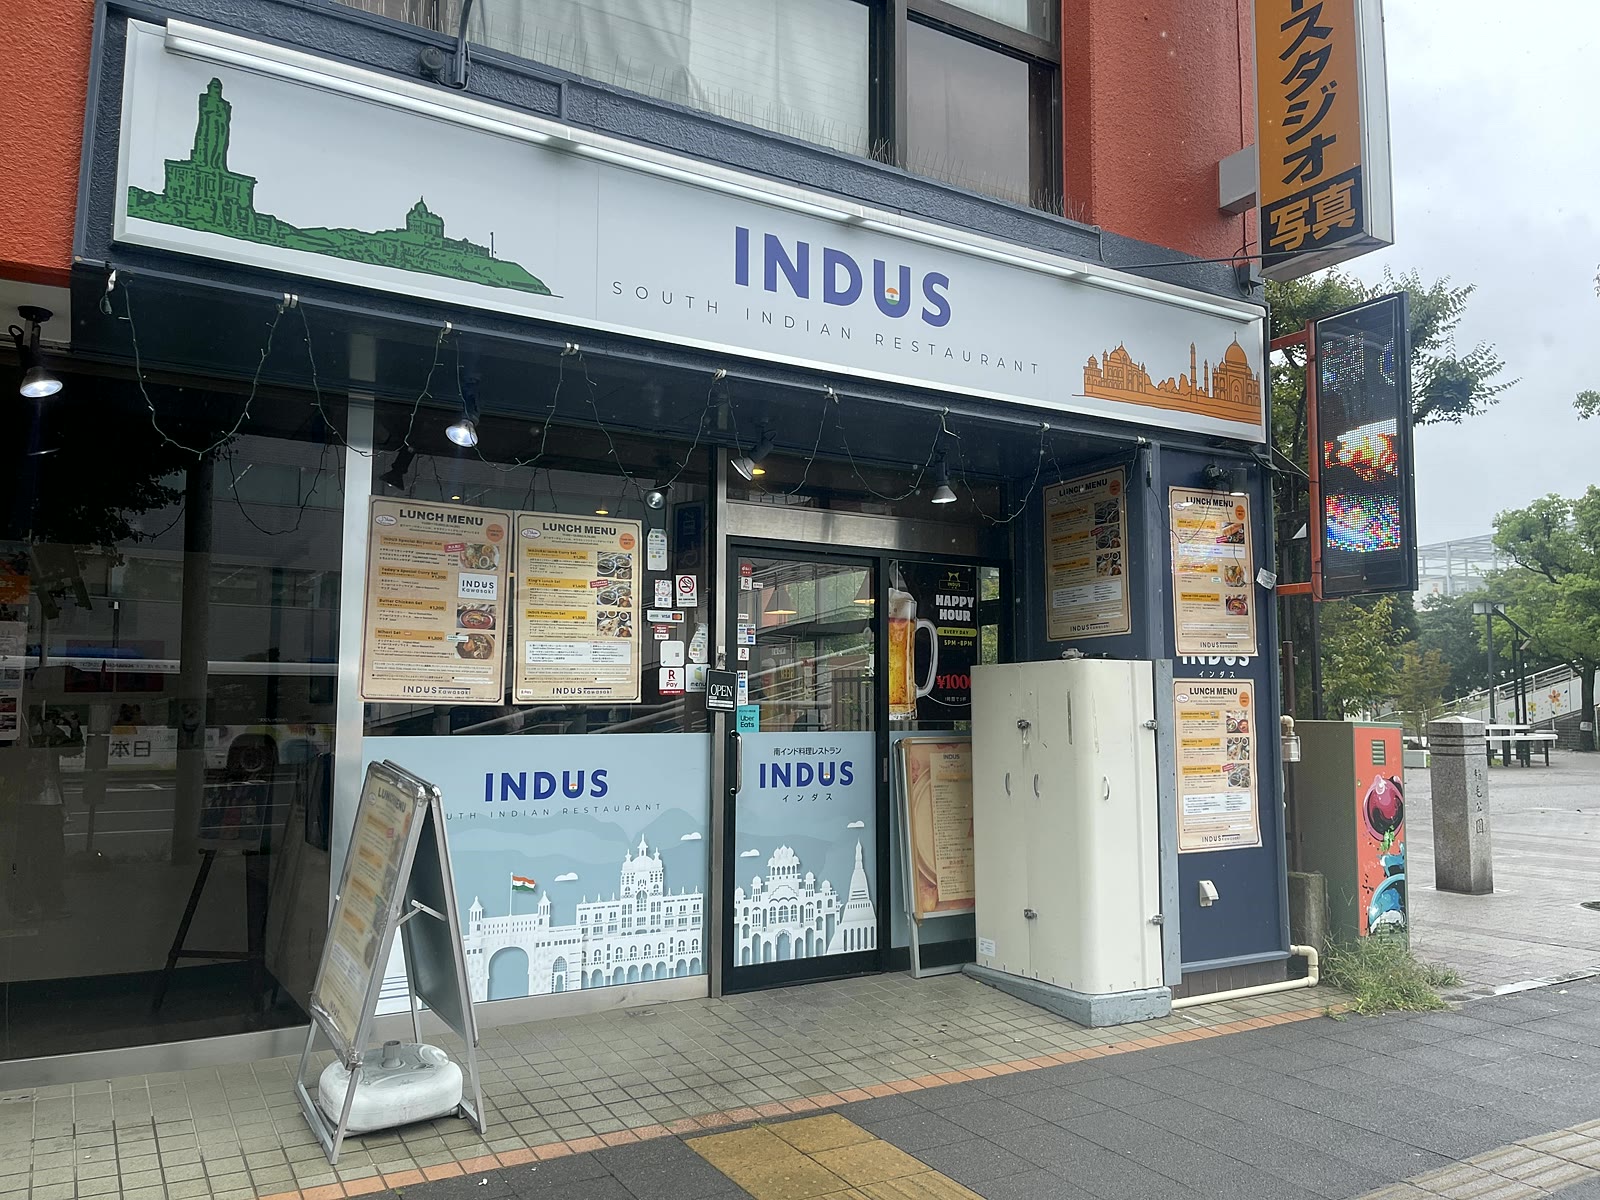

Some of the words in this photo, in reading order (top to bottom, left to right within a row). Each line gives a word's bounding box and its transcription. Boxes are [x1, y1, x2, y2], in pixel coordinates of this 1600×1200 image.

[1279, 0, 1337, 185] スタジオ
[1270, 178, 1356, 252] 写真
[735, 226, 951, 328] INDUS
[613, 281, 719, 315] SOUTH
[746, 307, 851, 341] INDIAN
[875, 333, 1039, 375] RESTAURANT
[1085, 478, 1108, 491] MENU
[1186, 496, 1210, 505] LUNCH
[1213, 499, 1234, 508] MENU
[400, 509, 444, 522] LUNCH
[447, 514, 484, 526] MENU
[542, 522, 582, 534] LUNCH
[584, 526, 617, 536] MENU
[462, 580, 495, 589] INDUS
[461, 587, 494, 595] Kawasaki
[935, 594, 975, 608] HAPPY
[939, 608, 971, 622] HOUR
[1070, 624, 1090, 632] INDUS
[668, 669, 676, 680] R
[1199, 670, 1236, 679] インダス
[403, 686, 437, 694] INDUS
[552, 687, 582, 695] INDUS
[665, 681, 678, 689] Pay
[710, 683, 734, 697] OPEN
[1189, 687, 1215, 695] LUNCH
[773, 746, 842, 756] 南インド料理レストラン
[759, 760, 854, 788] INDUS
[485, 769, 609, 802] INDUS
[782, 793, 833, 802] インダス
[446, 812, 477, 821] UTH
[490, 808, 550, 819] INDIAN
[562, 803, 662, 815] RESTAURANT
[1201, 835, 1222, 843] INDUS
